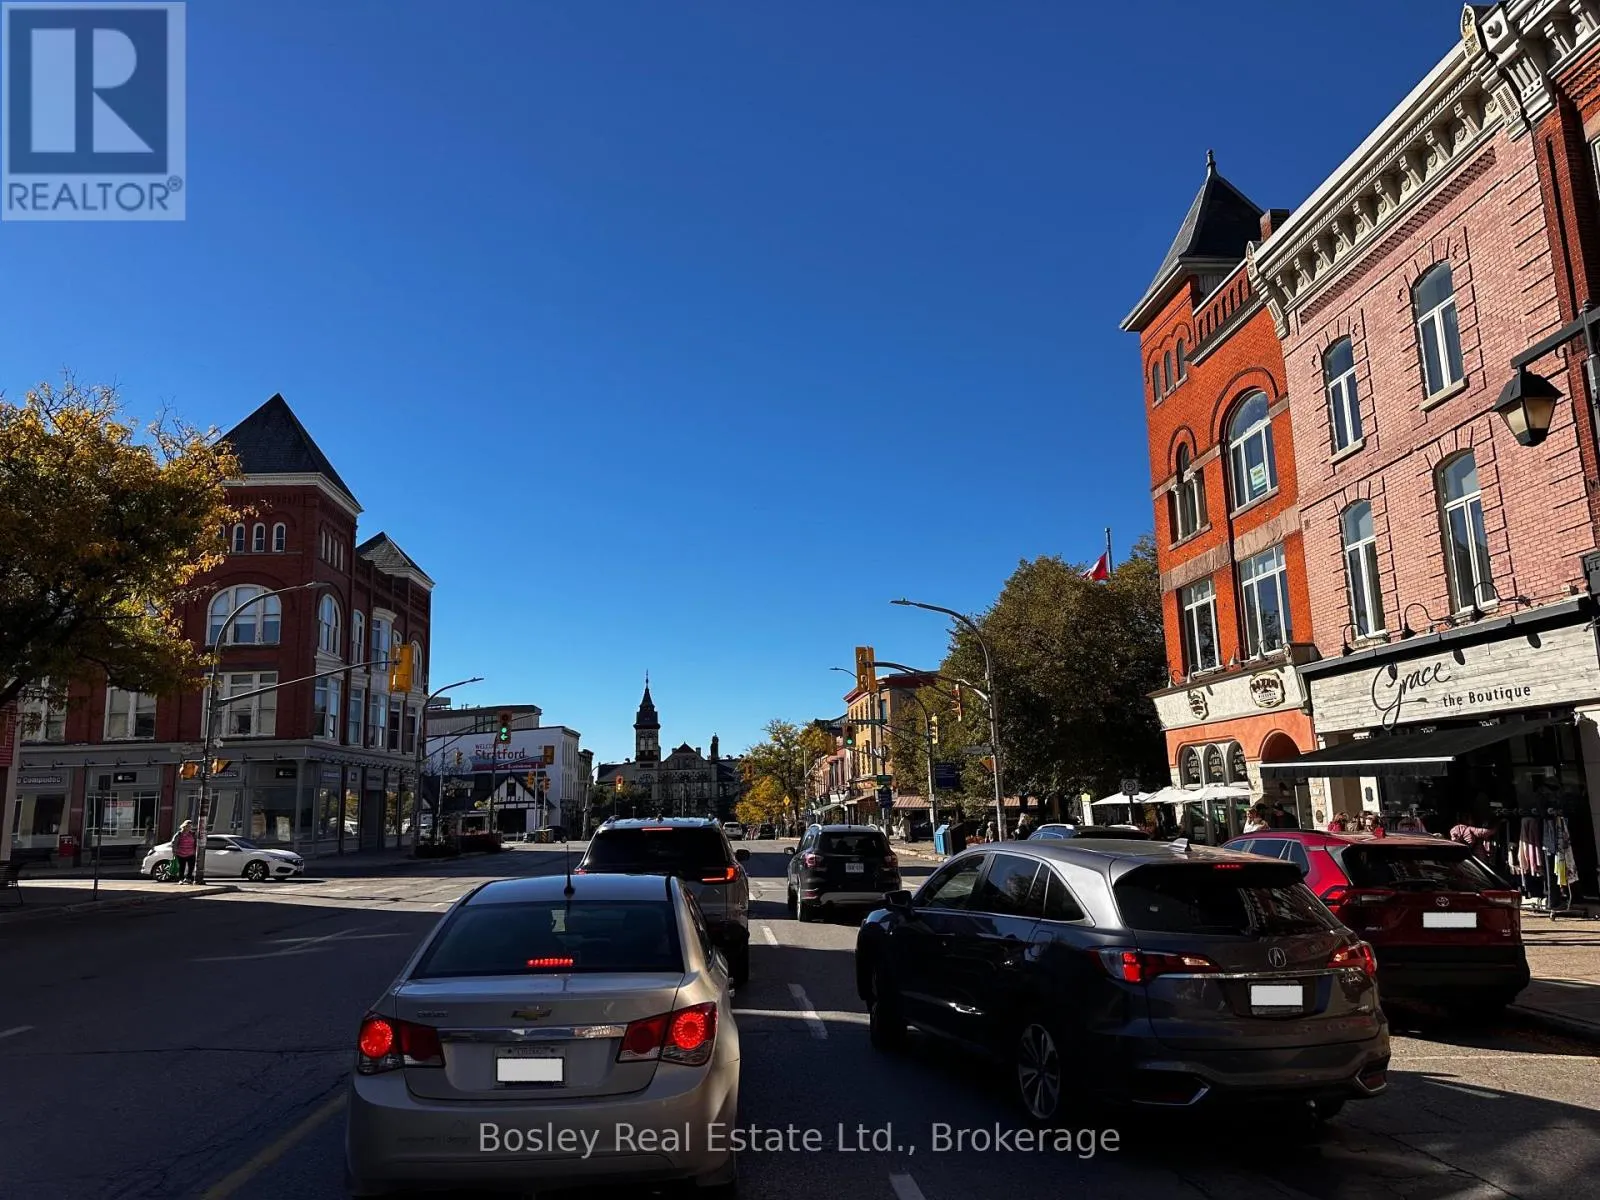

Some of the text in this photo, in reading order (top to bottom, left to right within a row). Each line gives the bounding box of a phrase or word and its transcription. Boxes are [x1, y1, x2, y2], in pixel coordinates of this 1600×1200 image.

[1371, 661, 1452, 731] Grace
[1442, 685, 1532, 708] the Boutique
